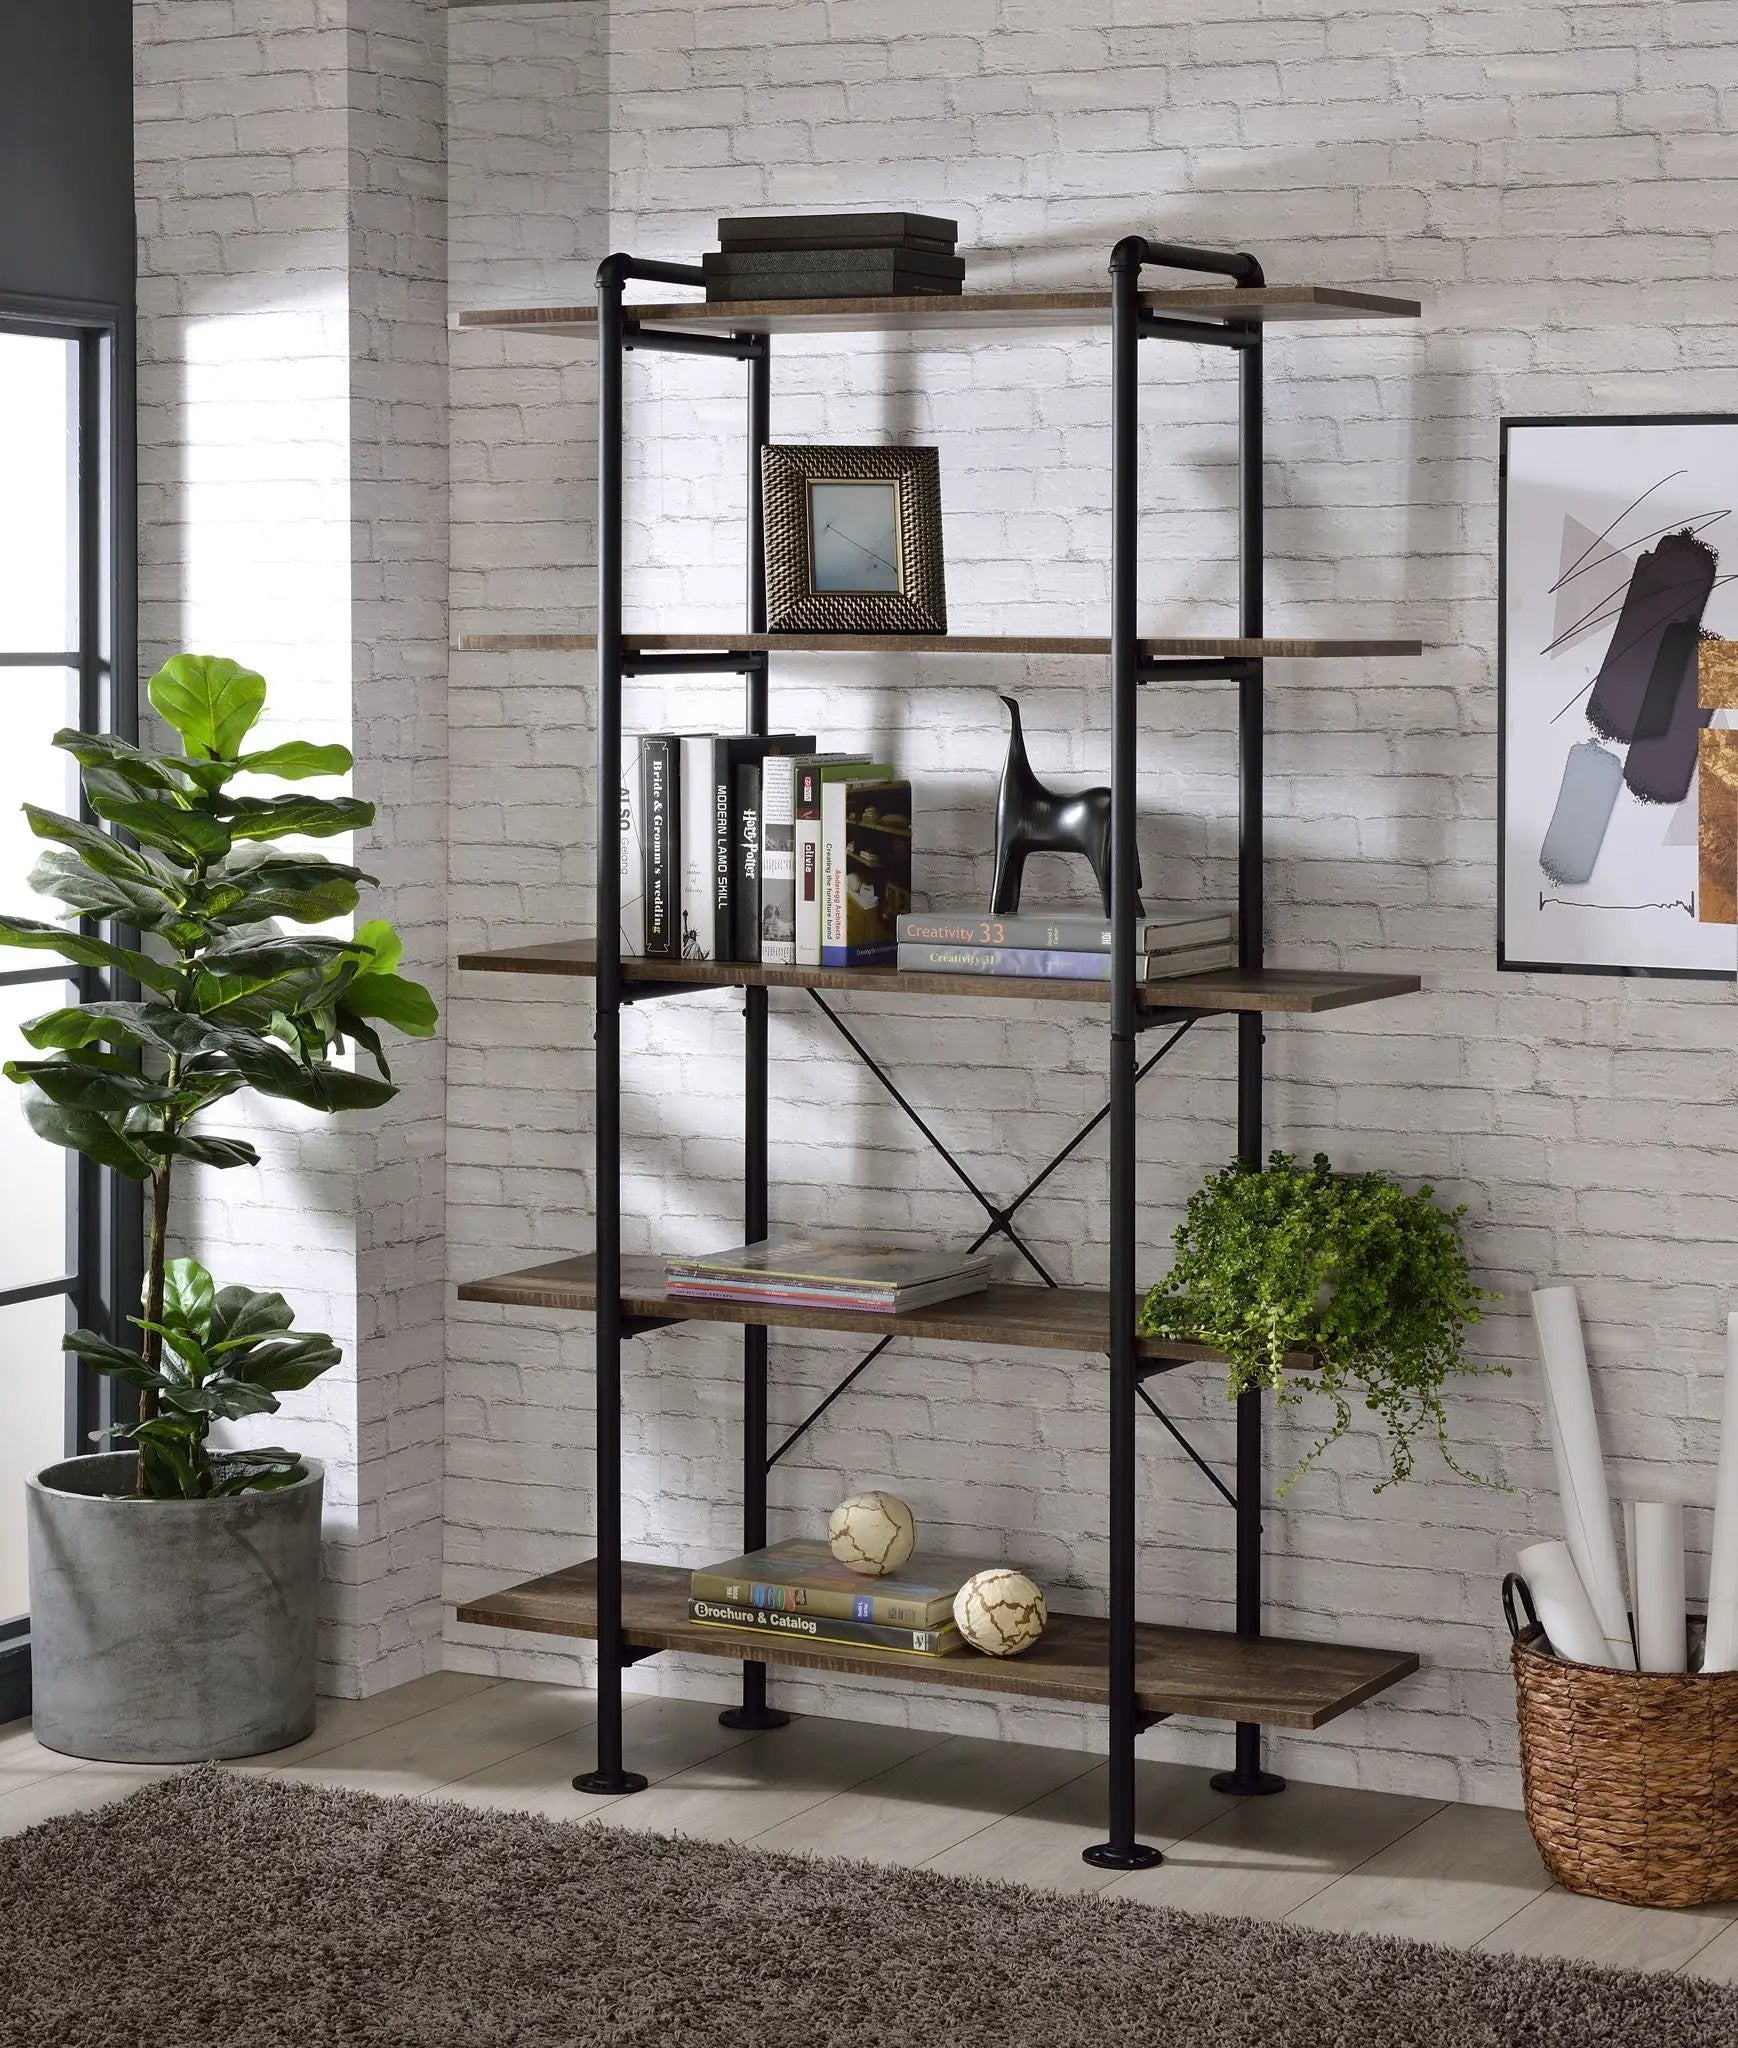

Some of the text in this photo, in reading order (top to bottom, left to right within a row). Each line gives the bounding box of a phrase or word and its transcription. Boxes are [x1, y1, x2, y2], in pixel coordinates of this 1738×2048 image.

[652, 760, 664, 934] Bride & Gromm's wedding
[717, 838, 728, 873] LAMO
[740, 808, 758, 880] Harry Potter
[805, 844, 815, 873] olivia
[825, 843, 833, 874] Creating
[717, 876, 728, 910] SKILL
[834, 904, 842, 940] Architects
[907, 922, 1005, 944] Creativity 33
[929, 952, 979, 966] Creativity
[694, 1602, 817, 1634] Brochure & Catalog
